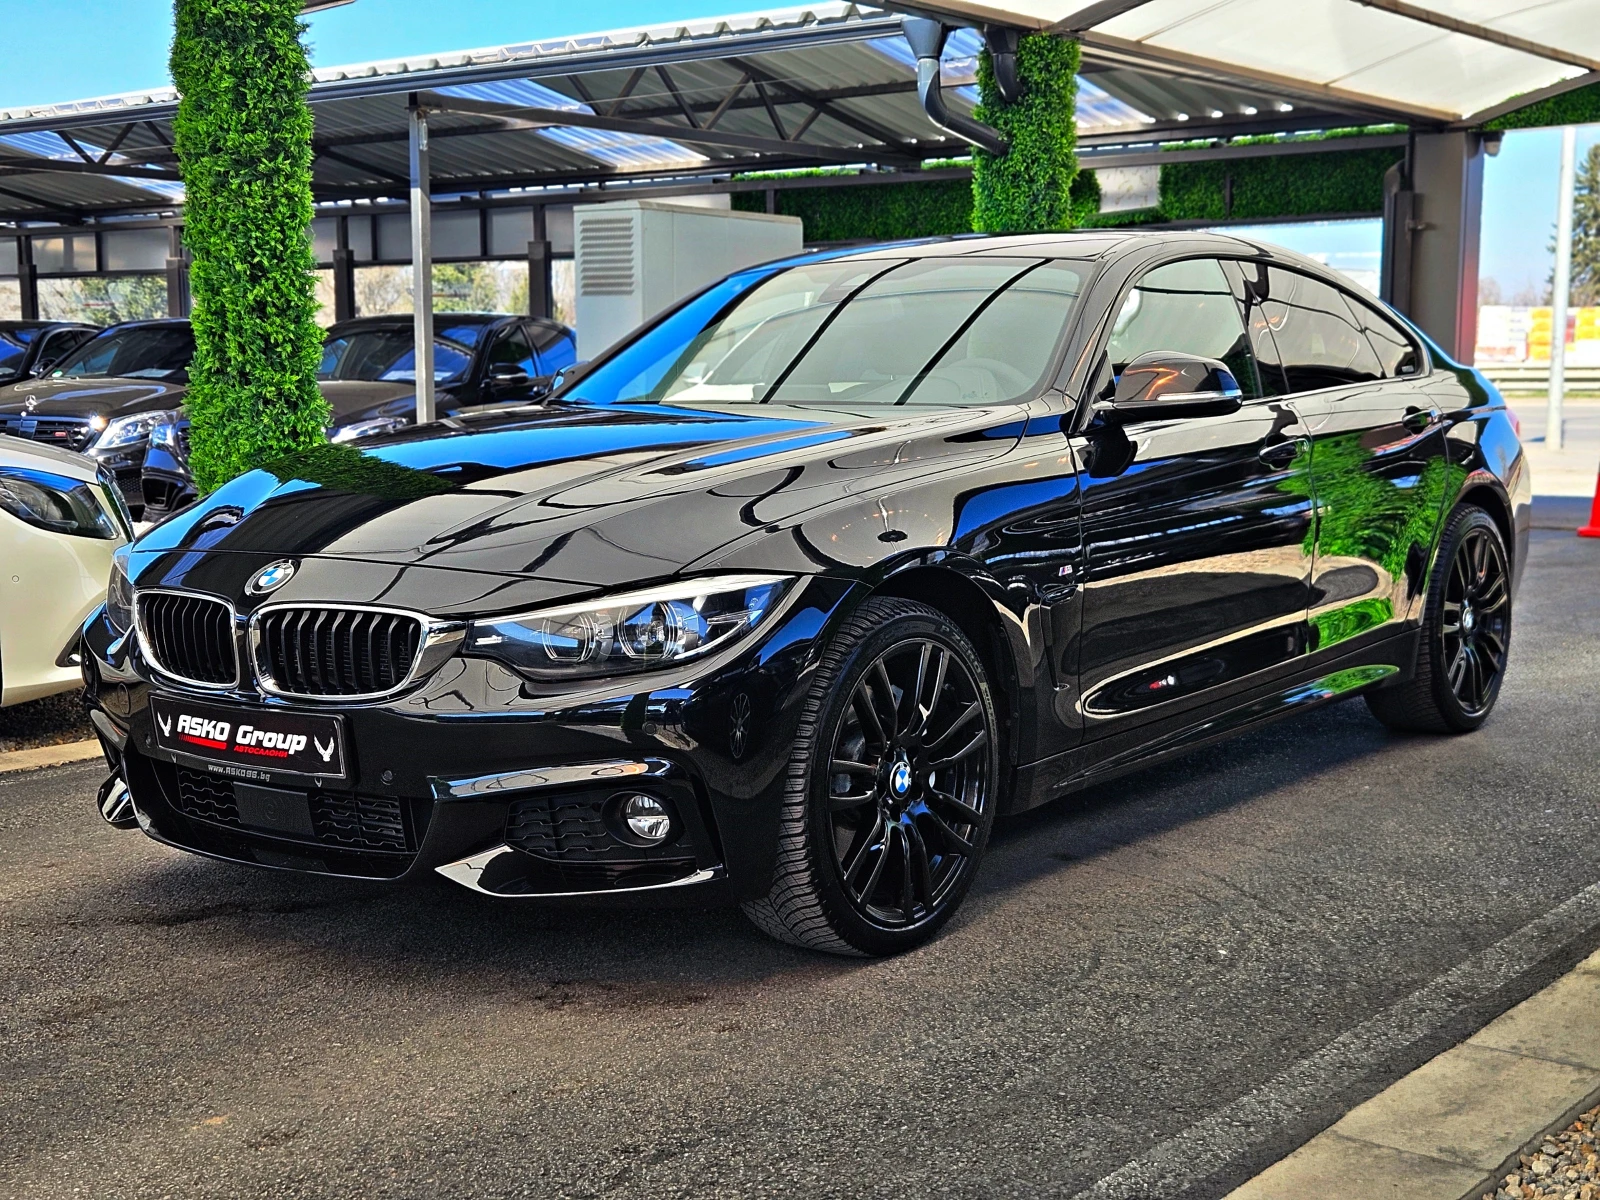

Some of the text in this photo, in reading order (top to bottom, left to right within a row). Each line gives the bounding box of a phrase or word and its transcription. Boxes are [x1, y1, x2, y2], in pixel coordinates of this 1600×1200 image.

[177, 714, 307, 754] ASKO Group
[233, 744, 289, 758] АВТОСАЛОНИ
